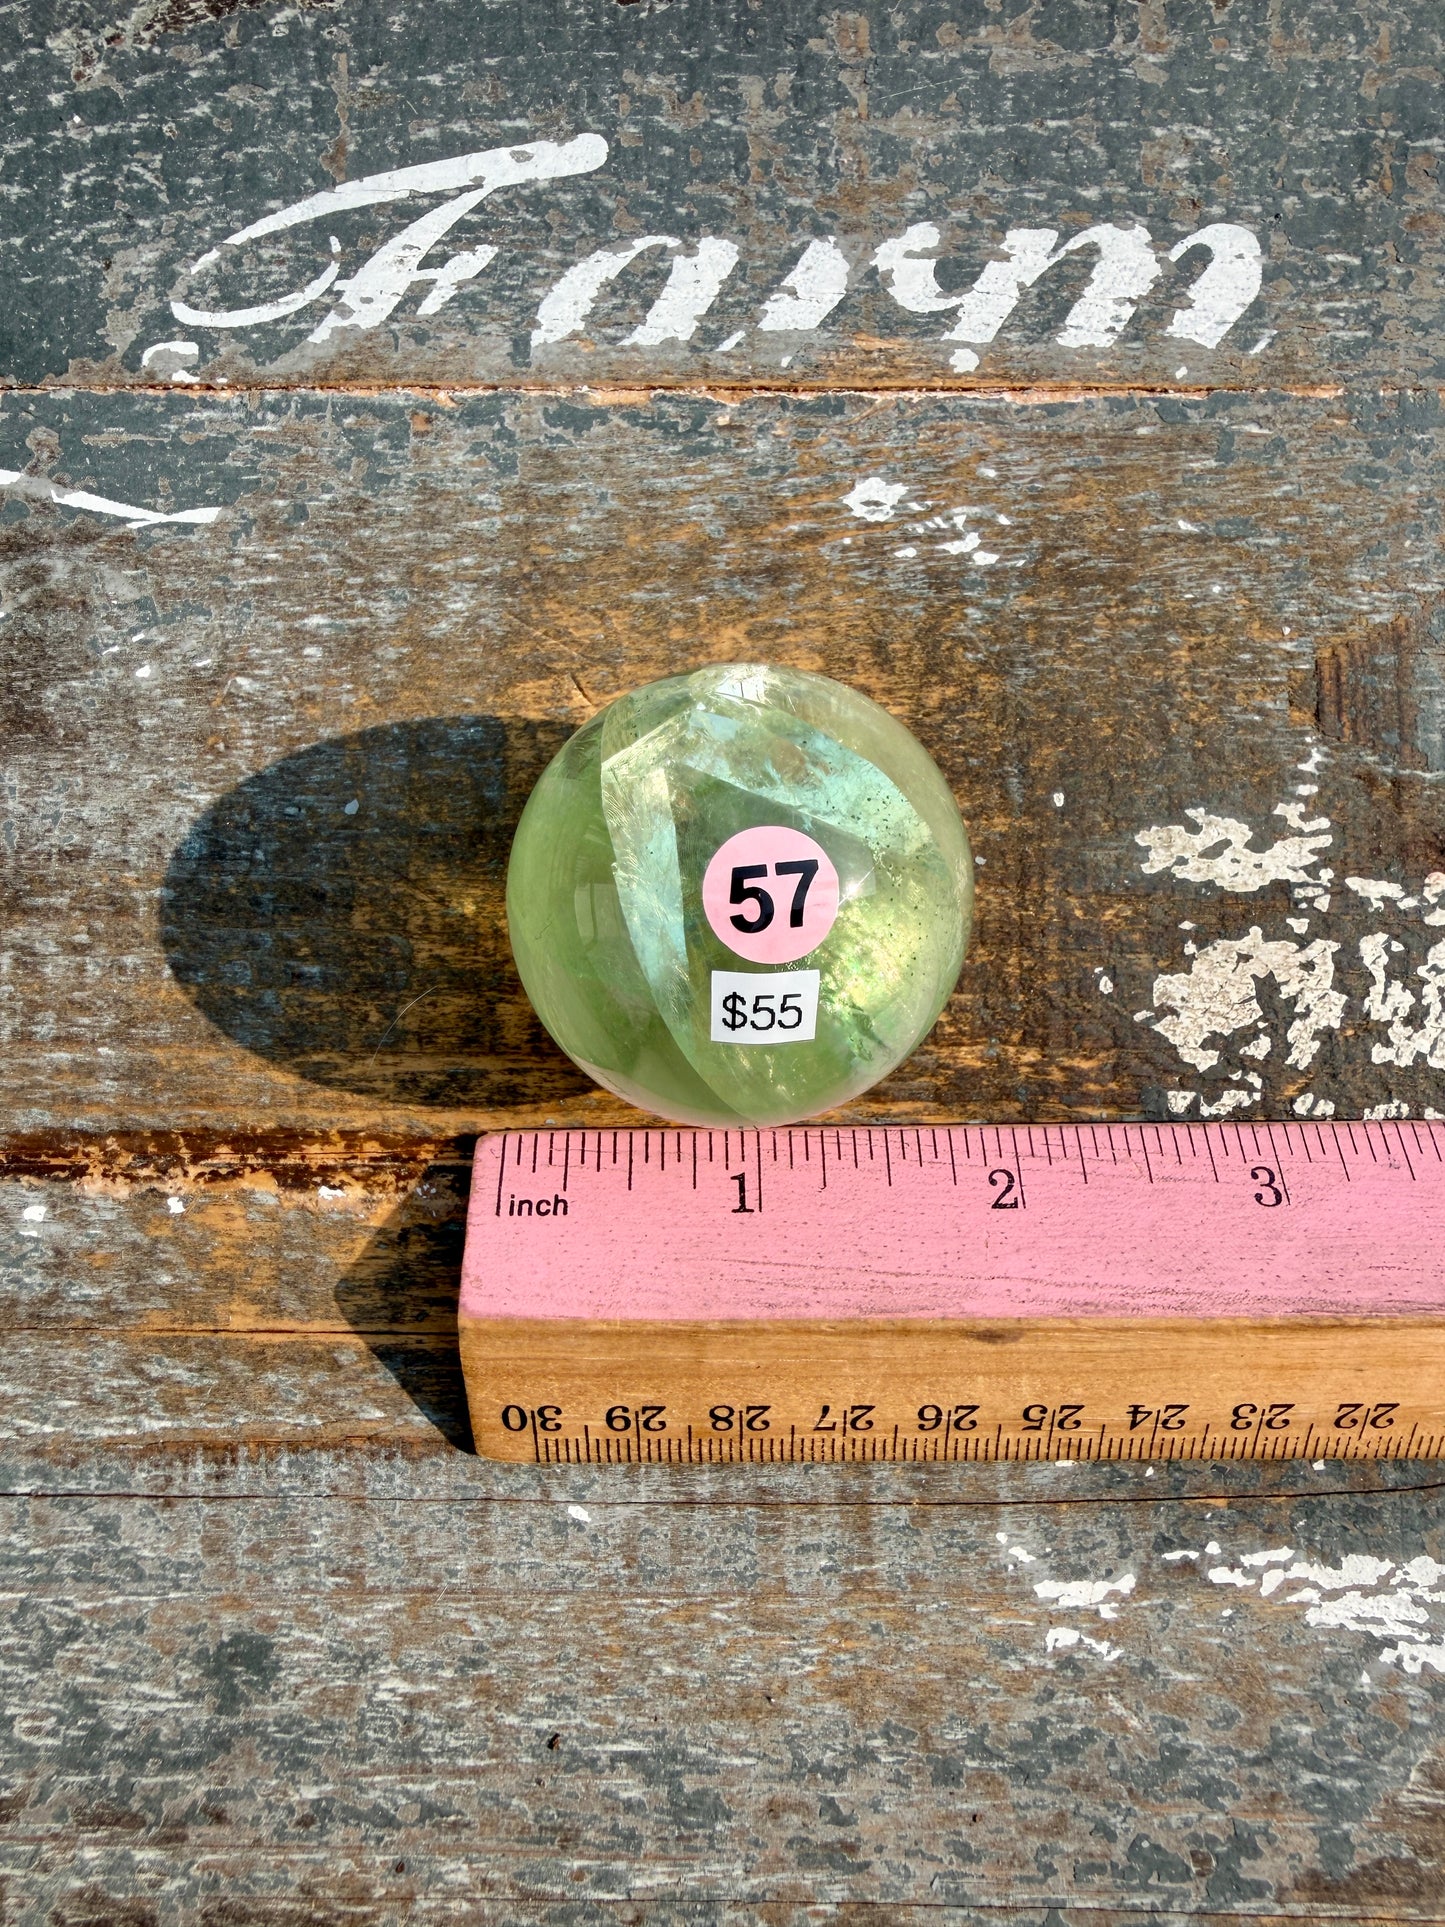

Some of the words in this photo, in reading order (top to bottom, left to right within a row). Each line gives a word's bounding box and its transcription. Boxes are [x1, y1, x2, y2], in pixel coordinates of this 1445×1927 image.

[729, 859, 819, 934] 57
[721, 991, 803, 1031] $55
[730, 1172, 755, 1213] 1
[988, 1168, 1019, 1209] 2
[1250, 1166, 1283, 1207] 3
[508, 1194, 569, 1217] inch
[501, 1404, 563, 1433] 30
[605, 1404, 667, 1432] 29
[708, 1404, 772, 1432] 28
[813, 1404, 876, 1432] 27
[917, 1404, 980, 1432] 26
[1022, 1403, 1085, 1431] 25
[1126, 1403, 1190, 1431] 24
[1231, 1403, 1296, 1431] 23
[1334, 1402, 1401, 1430] 22
